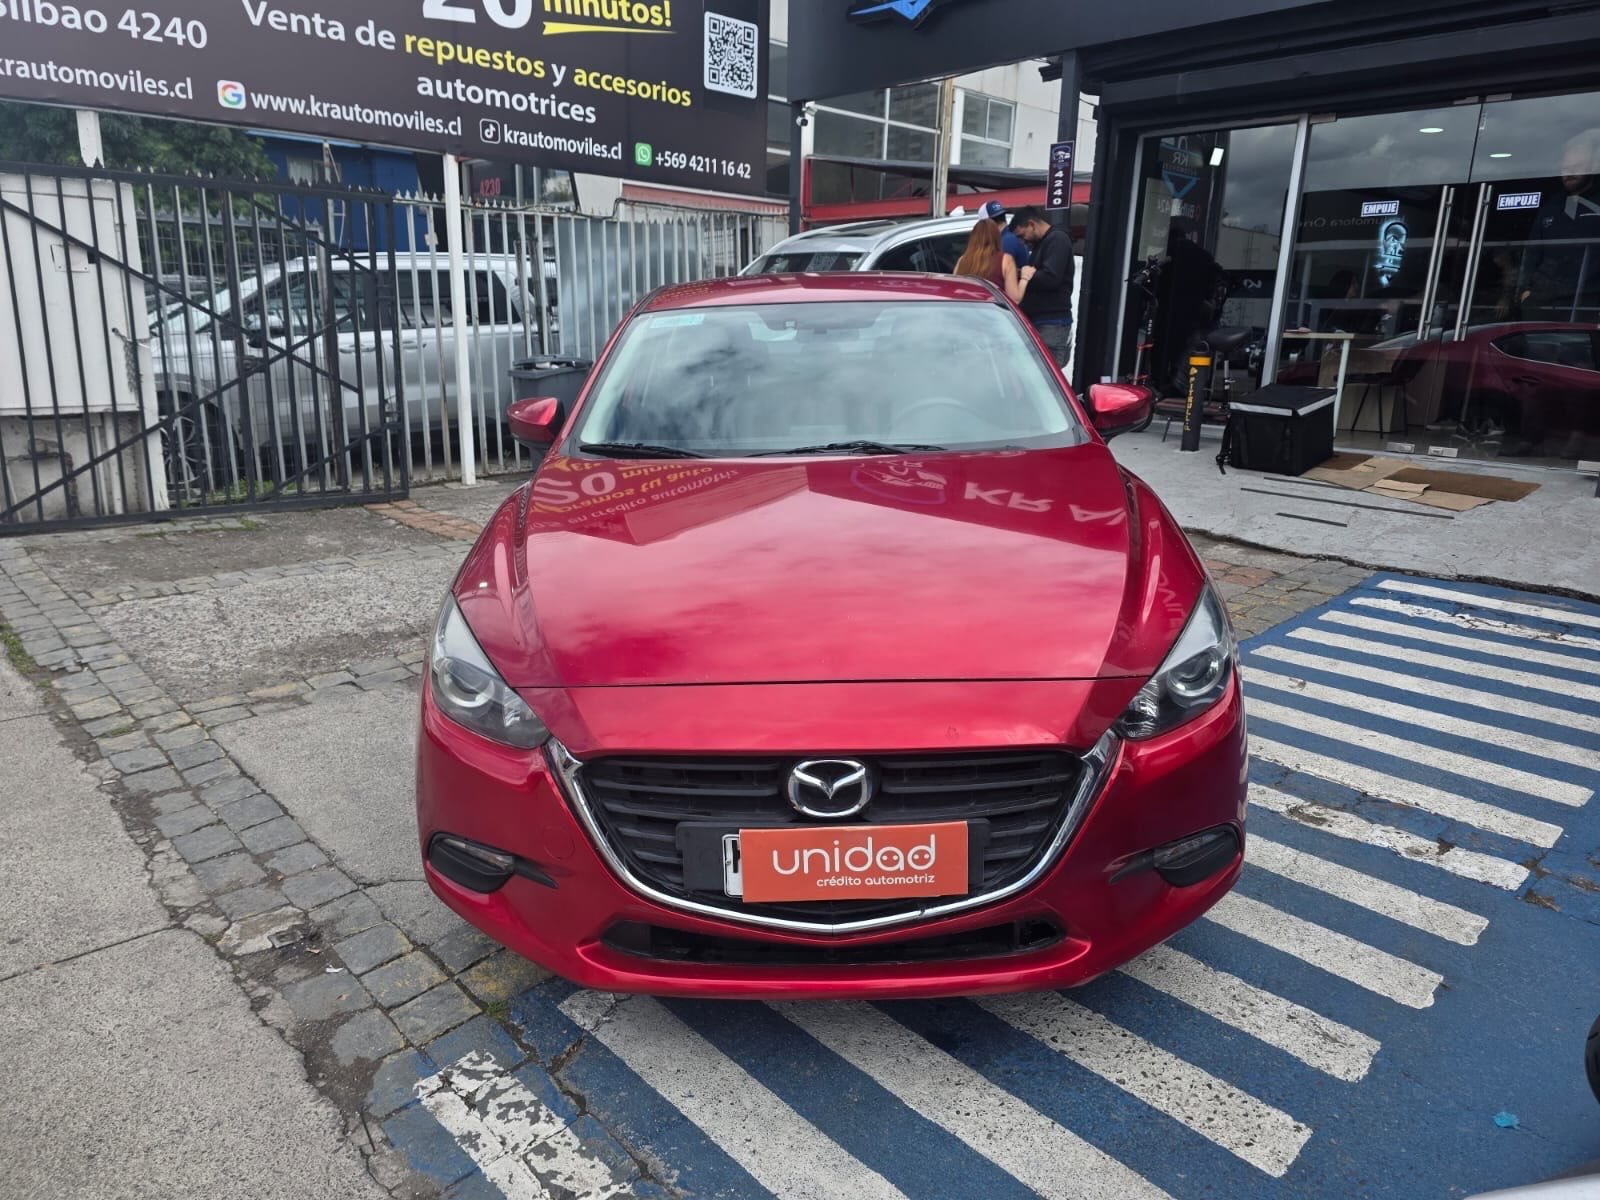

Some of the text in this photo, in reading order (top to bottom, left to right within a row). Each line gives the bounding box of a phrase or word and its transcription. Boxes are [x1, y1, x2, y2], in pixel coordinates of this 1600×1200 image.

[117, 9, 207, 48] 4240
[241, 0, 692, 107] Venta de repuestos y accesorios
[250, 91, 462, 136] www.krautomoviles.cl
[416, 76, 597, 123] automotrices
[503, 123, 622, 160] krautomoviles.cl
[654, 150, 752, 179] +569 4211 16 42
[1052, 170, 1064, 205] 4240
[1499, 194, 1539, 207] EMPUJE
[1363, 202, 1397, 215] EMPUJE
[772, 833, 936, 876] unidad
[816, 874, 936, 888] crédito automotriz
